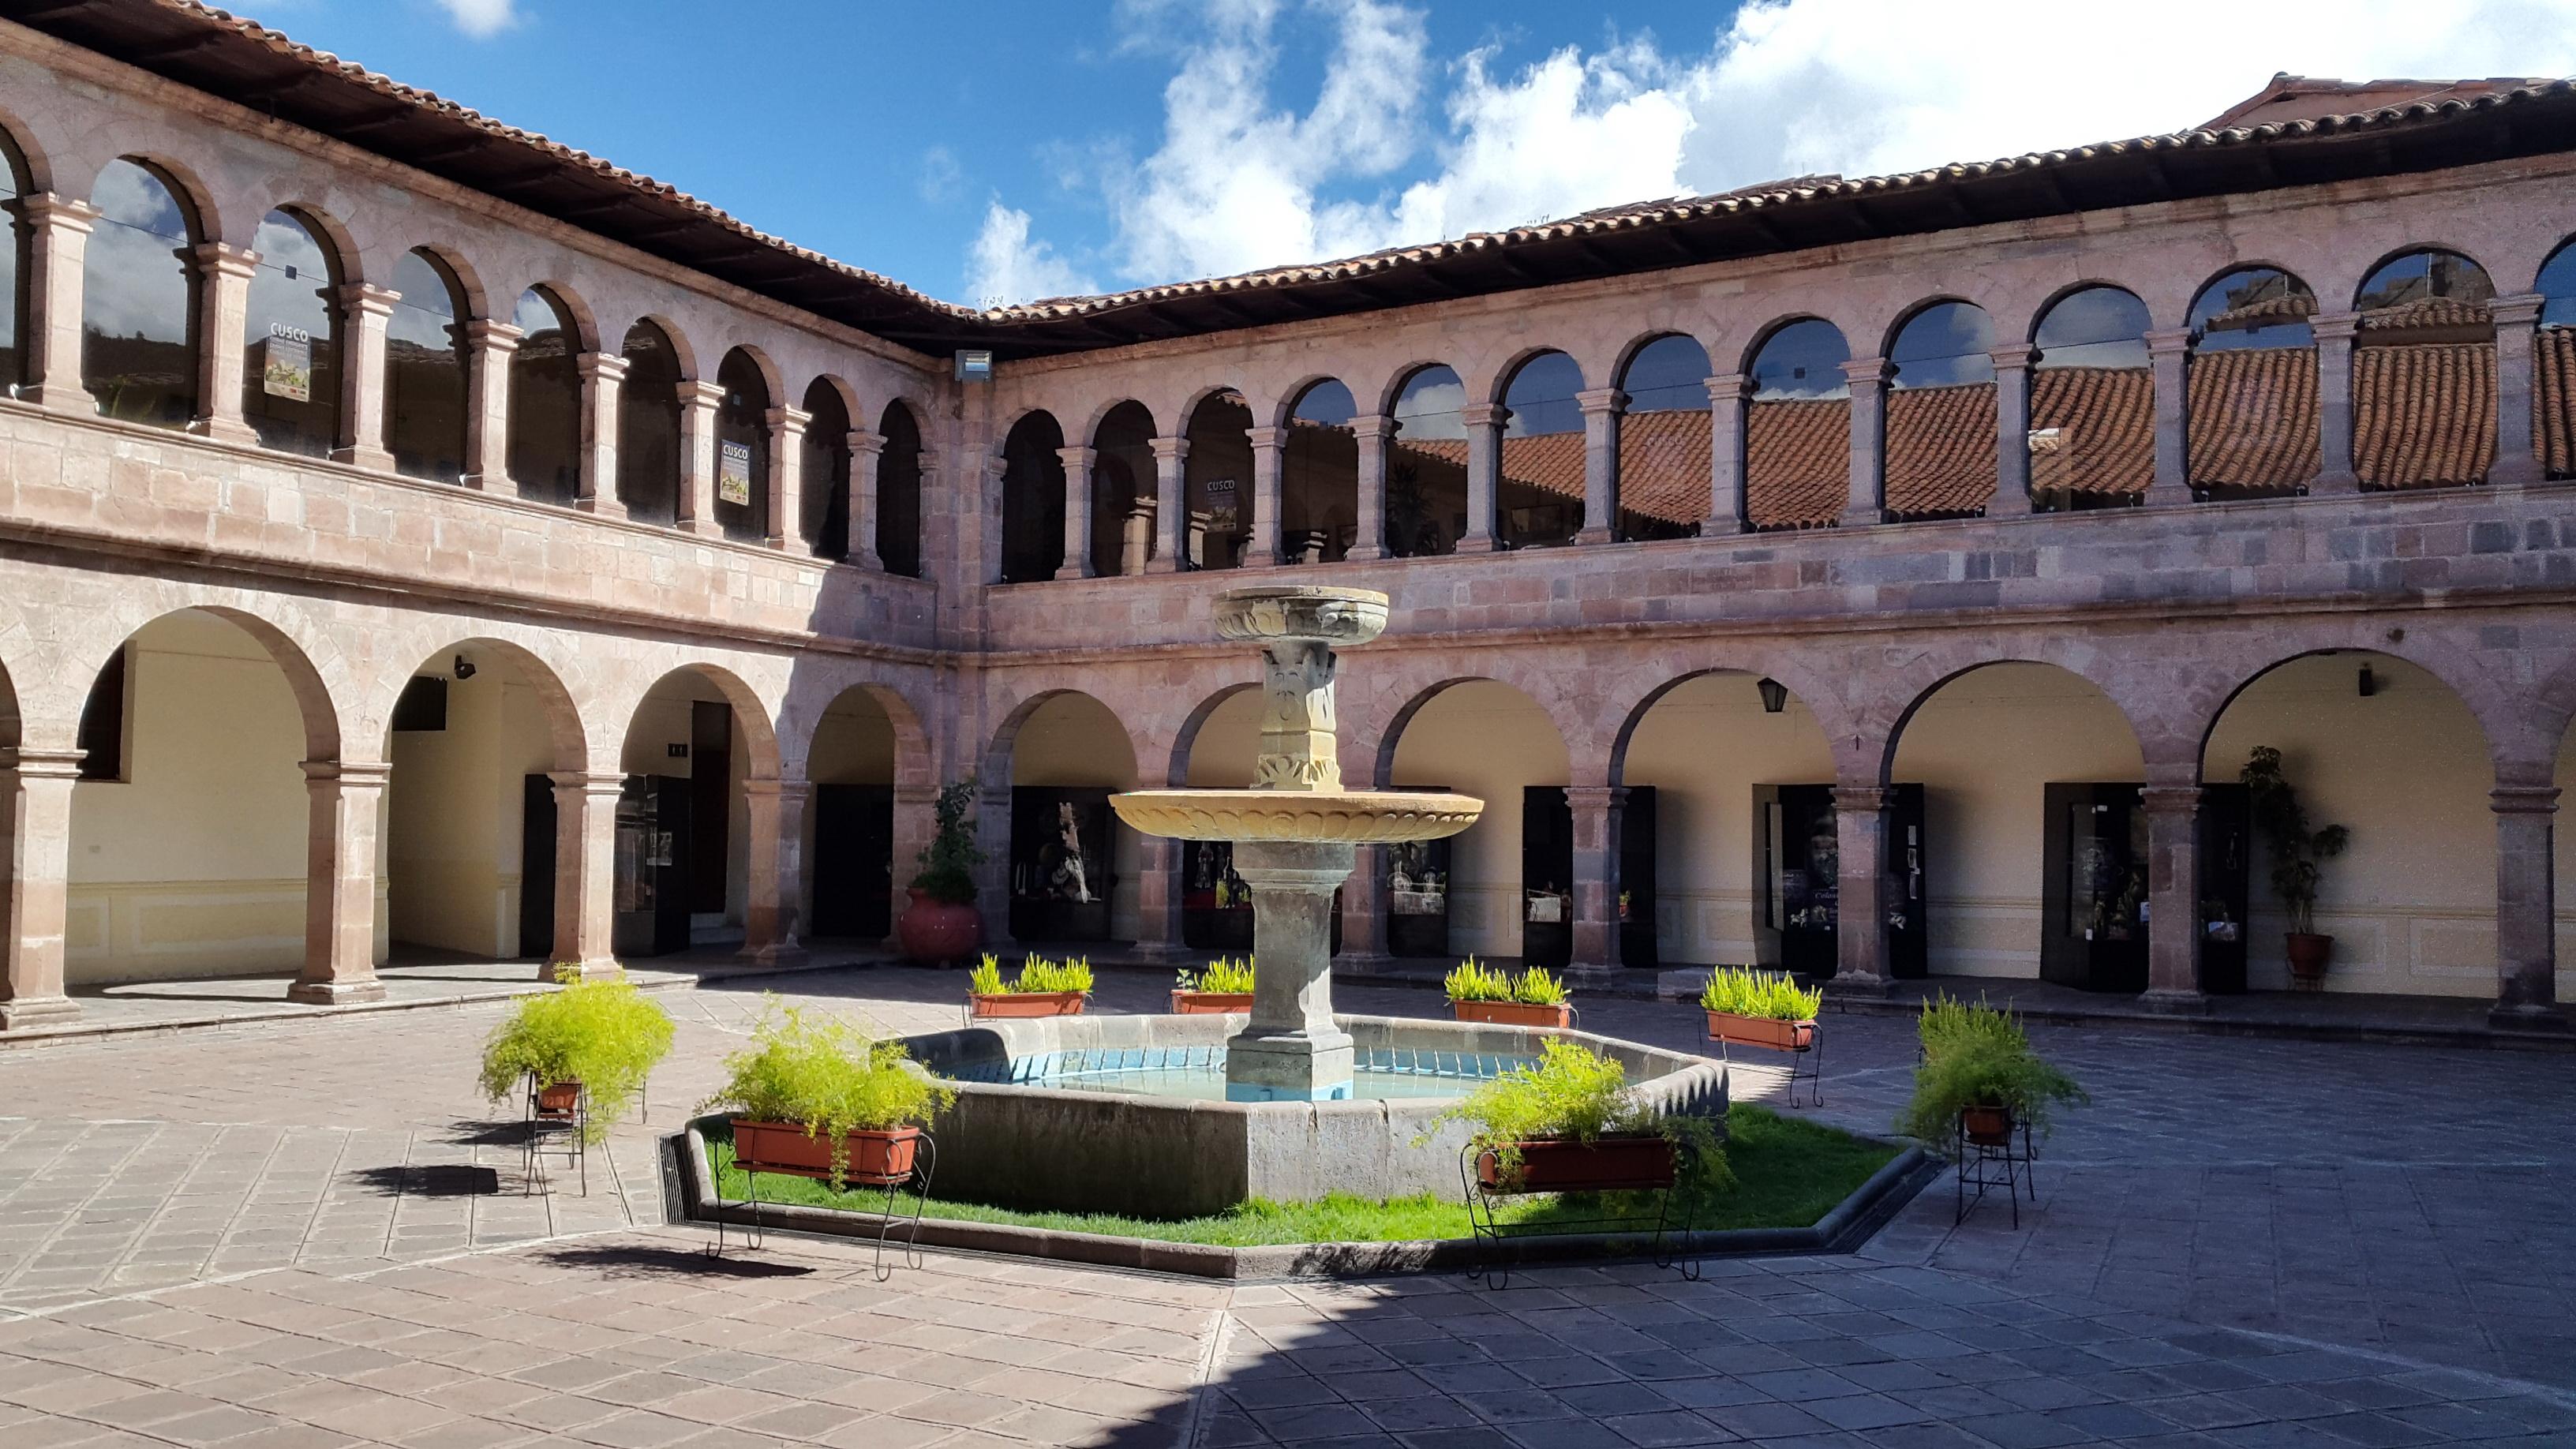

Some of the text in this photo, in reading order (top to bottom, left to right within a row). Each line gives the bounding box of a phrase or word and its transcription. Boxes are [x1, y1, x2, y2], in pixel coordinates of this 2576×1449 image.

[271, 323, 308, 342] CUSCO
[724, 445, 747, 459] CUSCO
[1208, 480, 1234, 491] CUSCO
